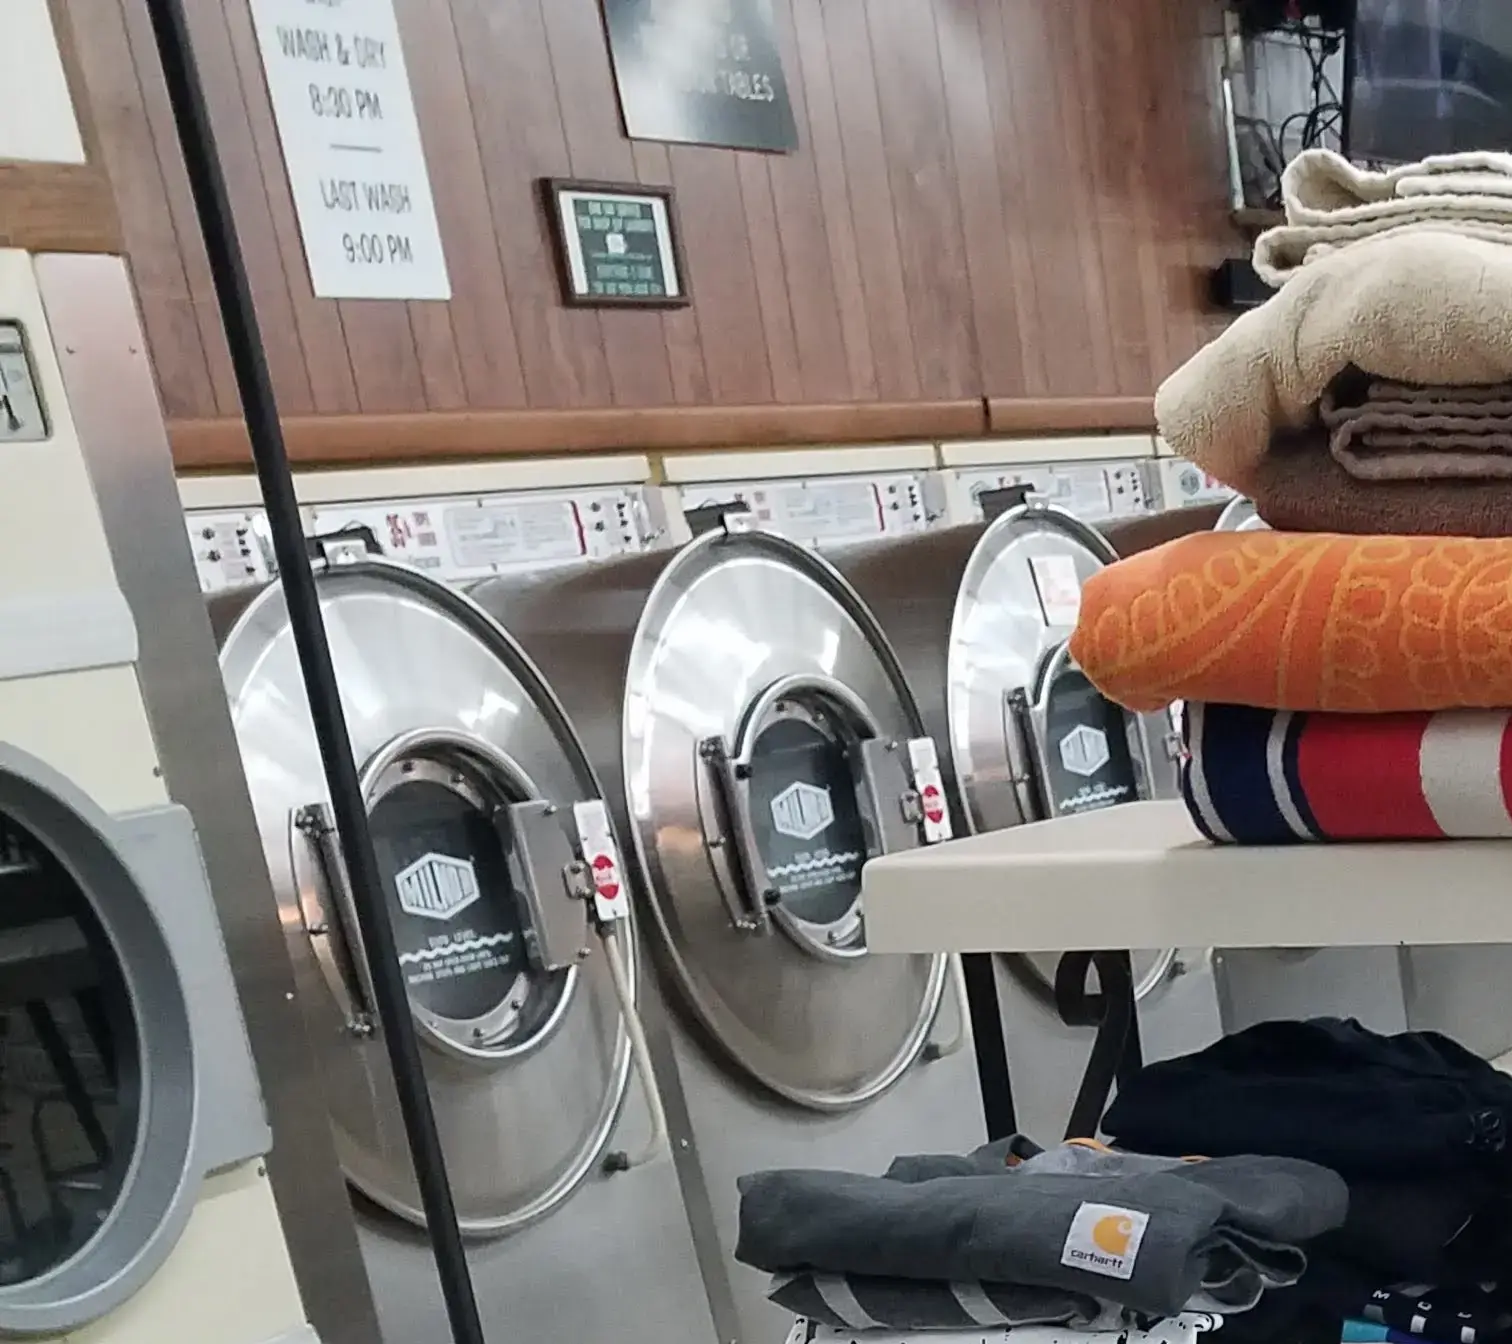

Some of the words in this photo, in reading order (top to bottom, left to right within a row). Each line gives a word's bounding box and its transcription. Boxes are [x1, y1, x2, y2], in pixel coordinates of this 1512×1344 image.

[277, 26, 331, 62] WASH
[335, 35, 349, 66] &
[353, 36, 386, 68] DRY
[309, 83, 352, 118] 8:30
[355, 88, 383, 119] PM
[320, 179, 360, 211] LAST
[363, 182, 412, 213] WASH
[343, 233, 384, 264] 9:00
[387, 234, 413, 263] PM
[1070, 1249, 1124, 1269] carhartt
